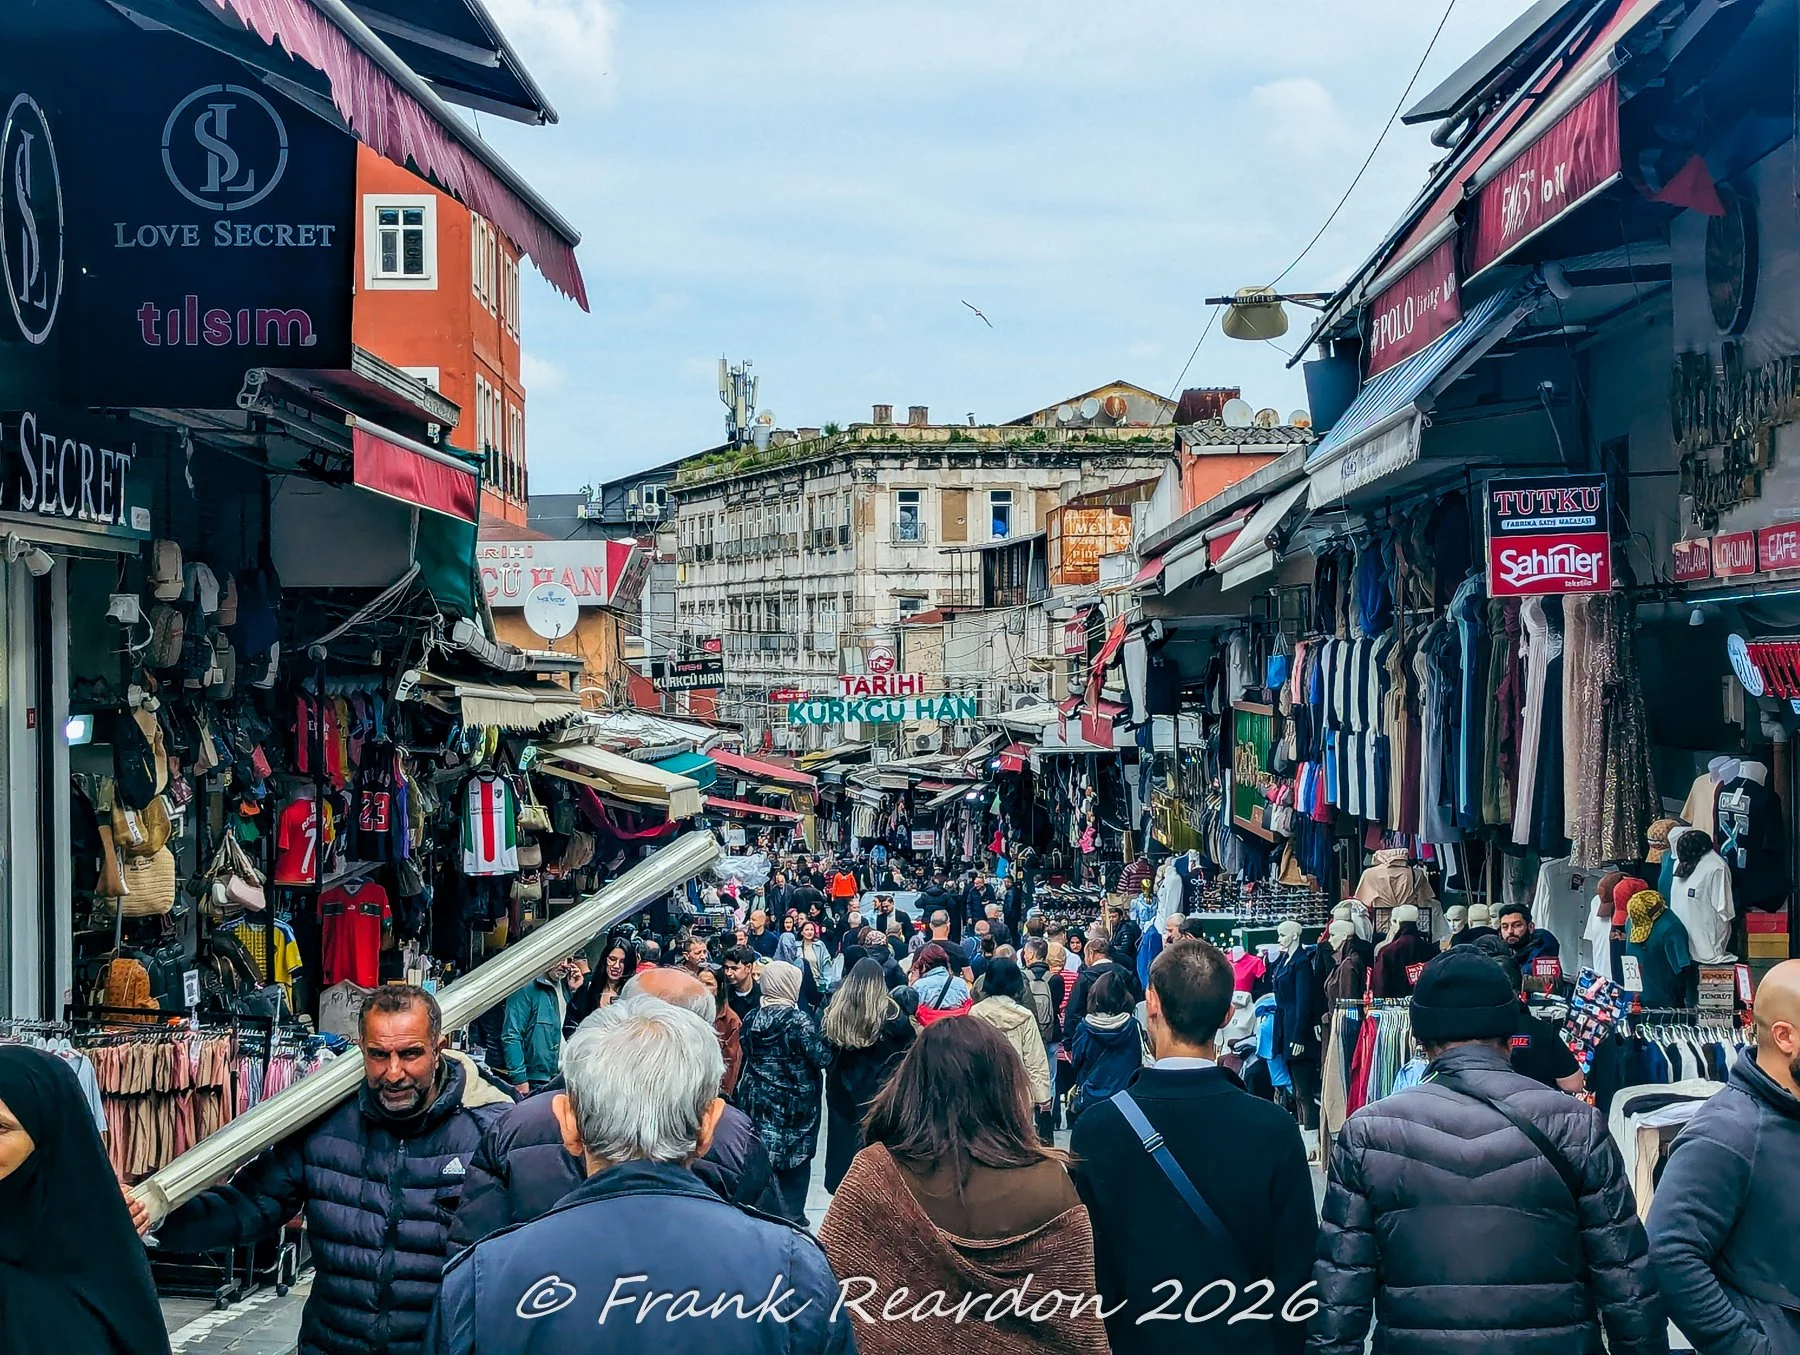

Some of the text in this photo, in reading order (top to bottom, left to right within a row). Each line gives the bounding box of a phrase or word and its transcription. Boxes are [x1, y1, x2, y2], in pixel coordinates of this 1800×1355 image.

[114, 220, 335, 247] LOVE SECRET
[1380, 296, 1414, 351] POLO
[19, 411, 131, 527] SECRET
[1494, 487, 1602, 516] TUTKU
[477, 545, 533, 559] RİHİ
[1714, 540, 1751, 569] LOKUM
[1767, 531, 1798, 561] CAFE
[530, 567, 604, 597] HAN
[700, 672, 723, 685] HAN
[839, 672, 925, 696] TARİHİ
[916, 696, 977, 720] HAN
[359, 790, 390, 832] 23
